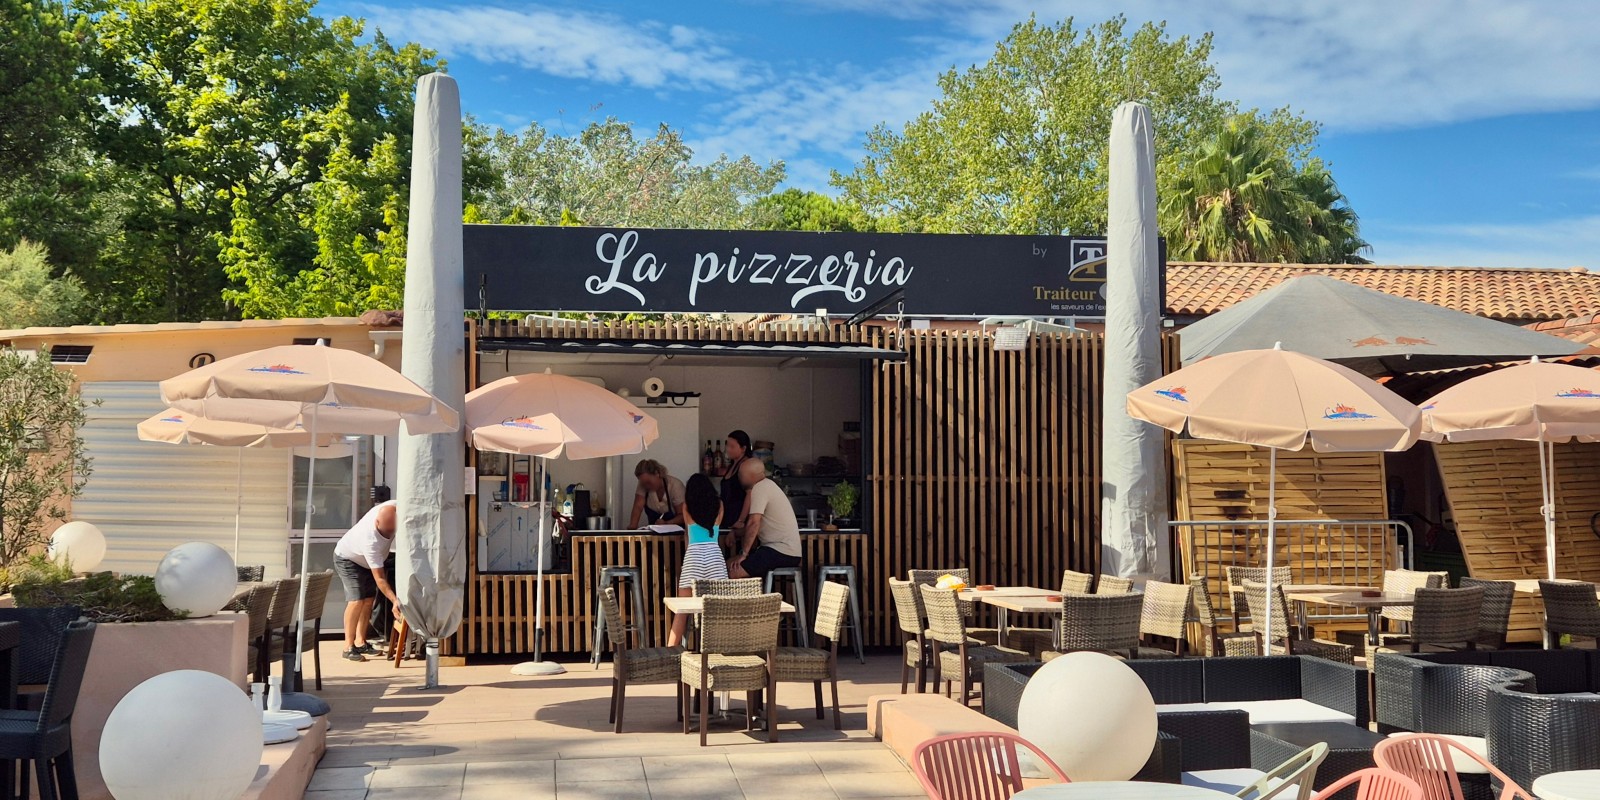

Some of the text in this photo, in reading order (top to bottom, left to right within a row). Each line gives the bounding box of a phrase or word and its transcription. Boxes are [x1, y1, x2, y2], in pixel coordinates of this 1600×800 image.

[1032, 243, 1047, 258] by
[585, 231, 915, 308] La pizzeria
[1033, 286, 1096, 300] Traiteur
